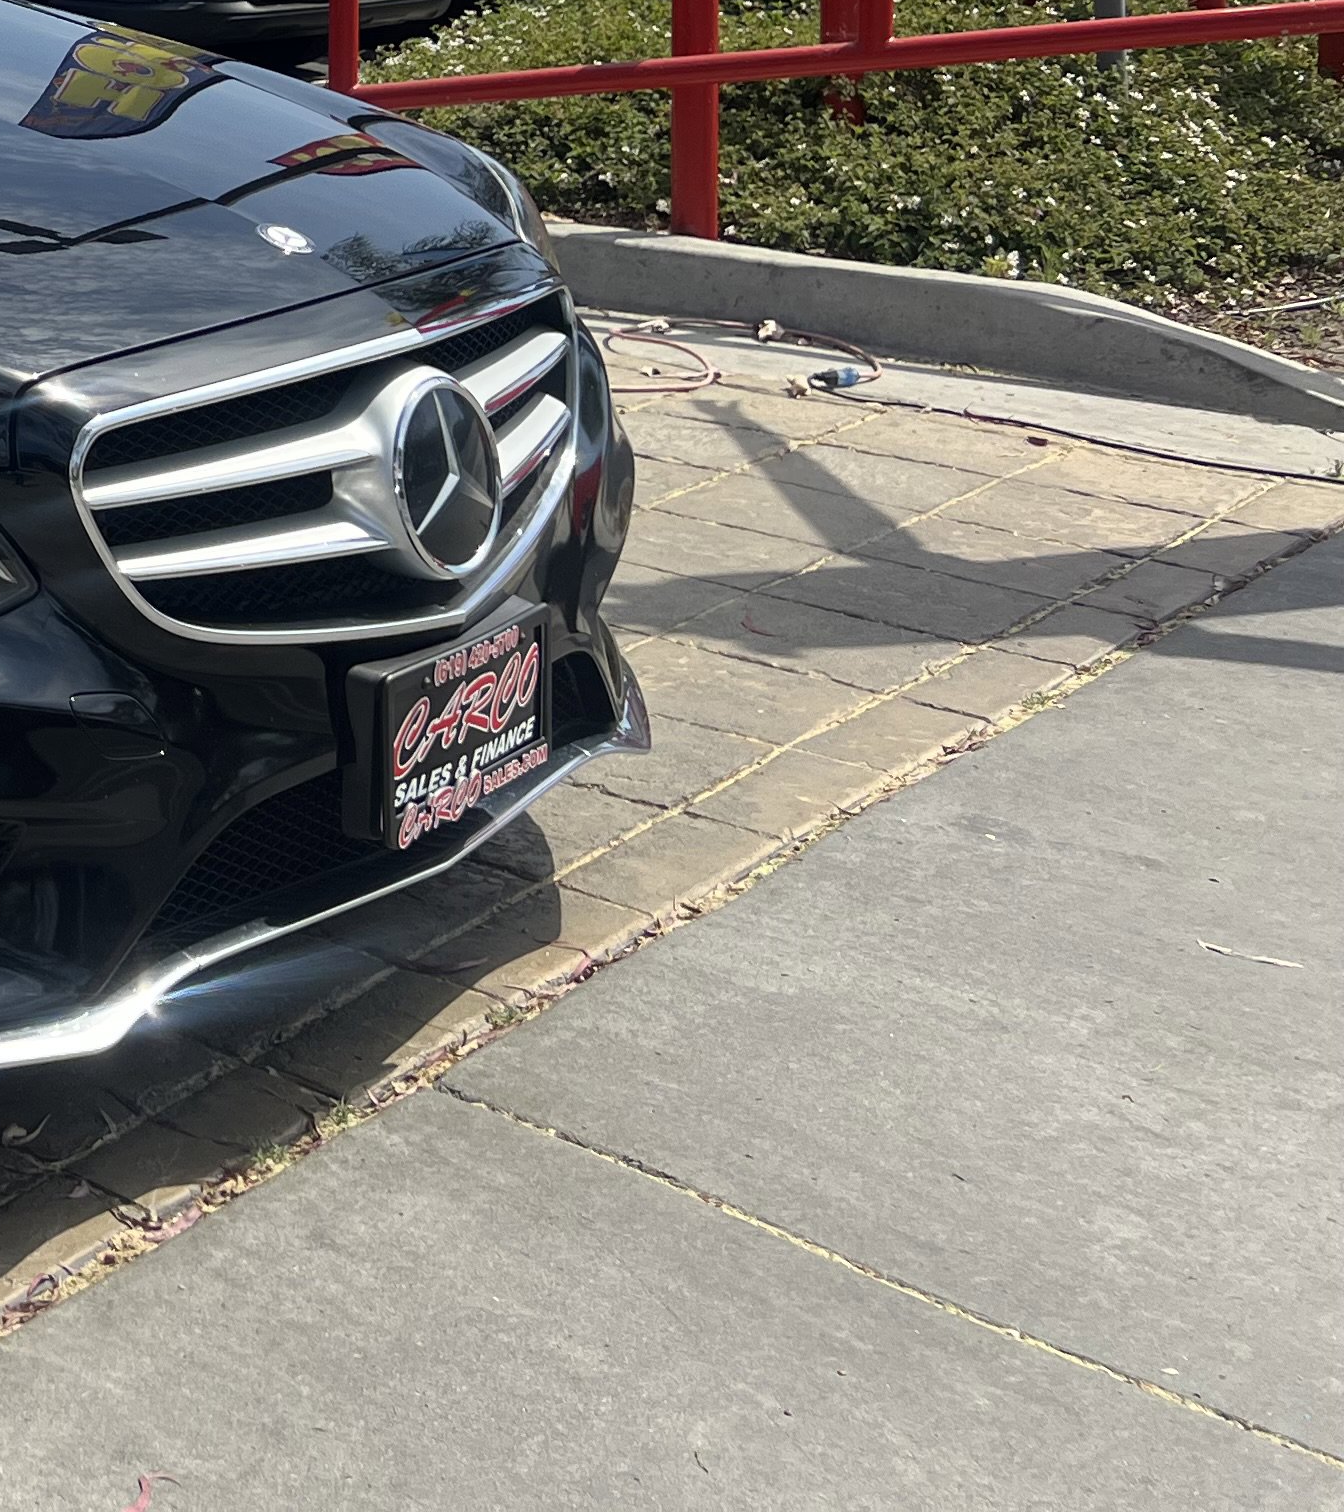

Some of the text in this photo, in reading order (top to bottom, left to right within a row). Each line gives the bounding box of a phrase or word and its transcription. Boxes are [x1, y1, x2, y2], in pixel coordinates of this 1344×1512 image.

[434, 625, 520, 687] (619) 420-5700
[394, 642, 540, 780] CARCO
[394, 715, 536, 808] SALES & FINANCE
